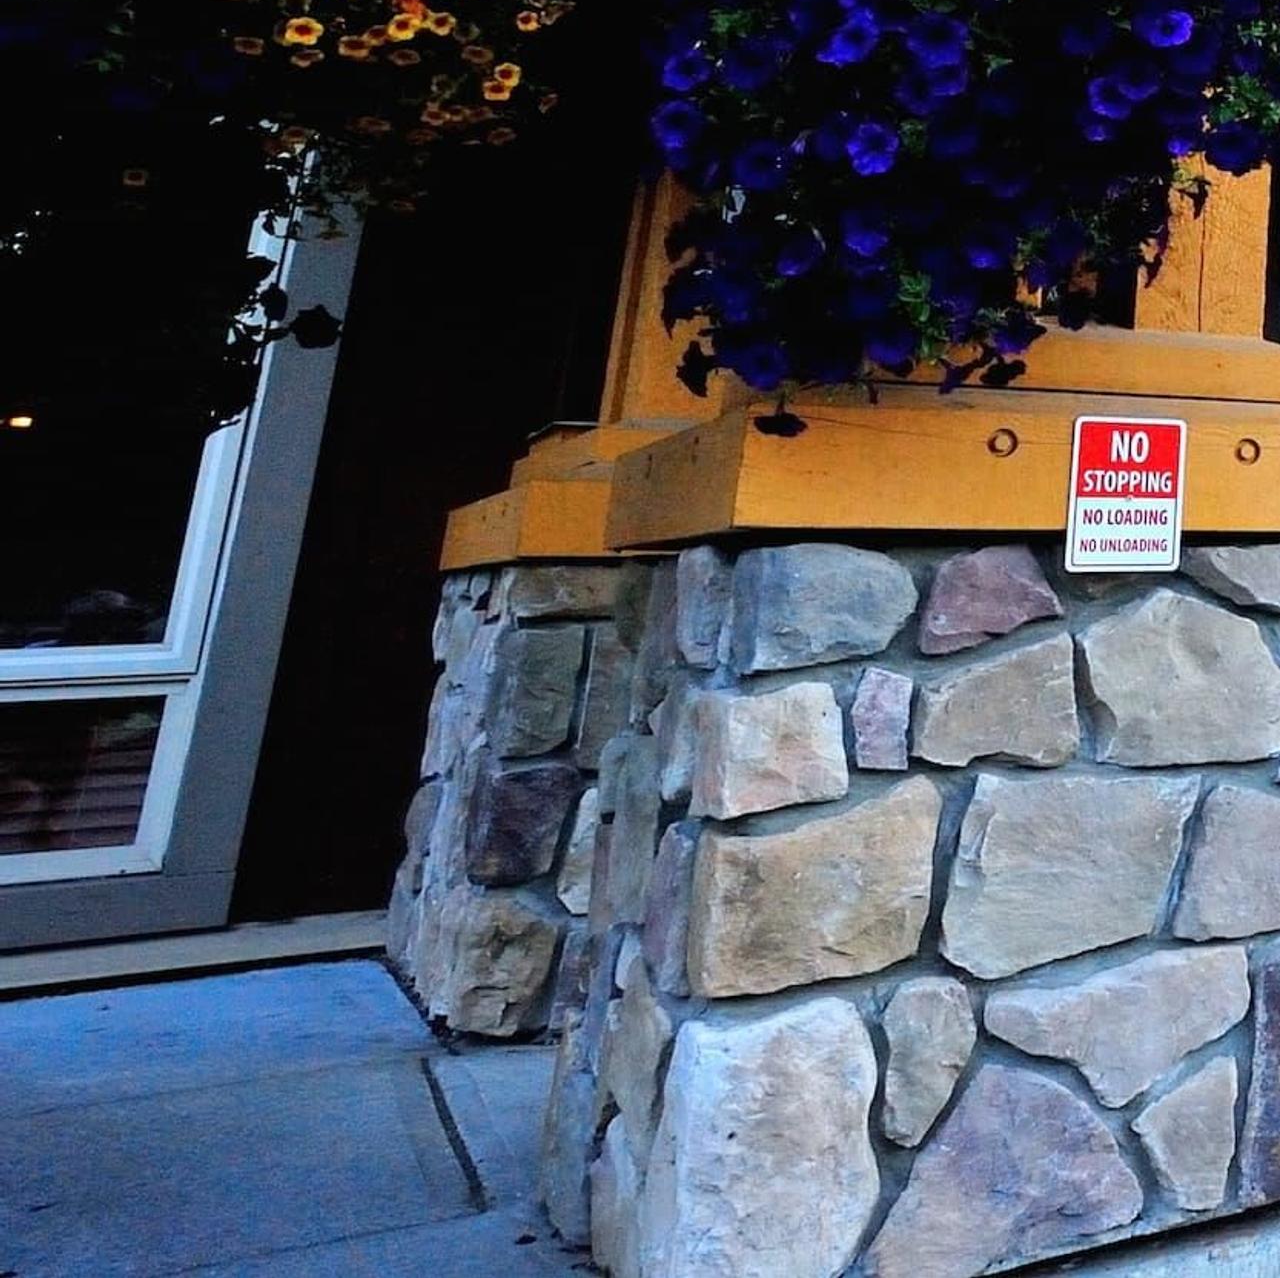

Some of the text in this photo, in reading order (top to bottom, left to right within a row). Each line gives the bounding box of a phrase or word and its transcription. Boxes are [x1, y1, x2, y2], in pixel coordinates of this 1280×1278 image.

[1110, 430, 1150, 464] NO
[1082, 469, 1173, 493] STOPPING
[1082, 509, 1168, 525] NO LOADING
[1079, 538, 1168, 553] NO UNLOADING
